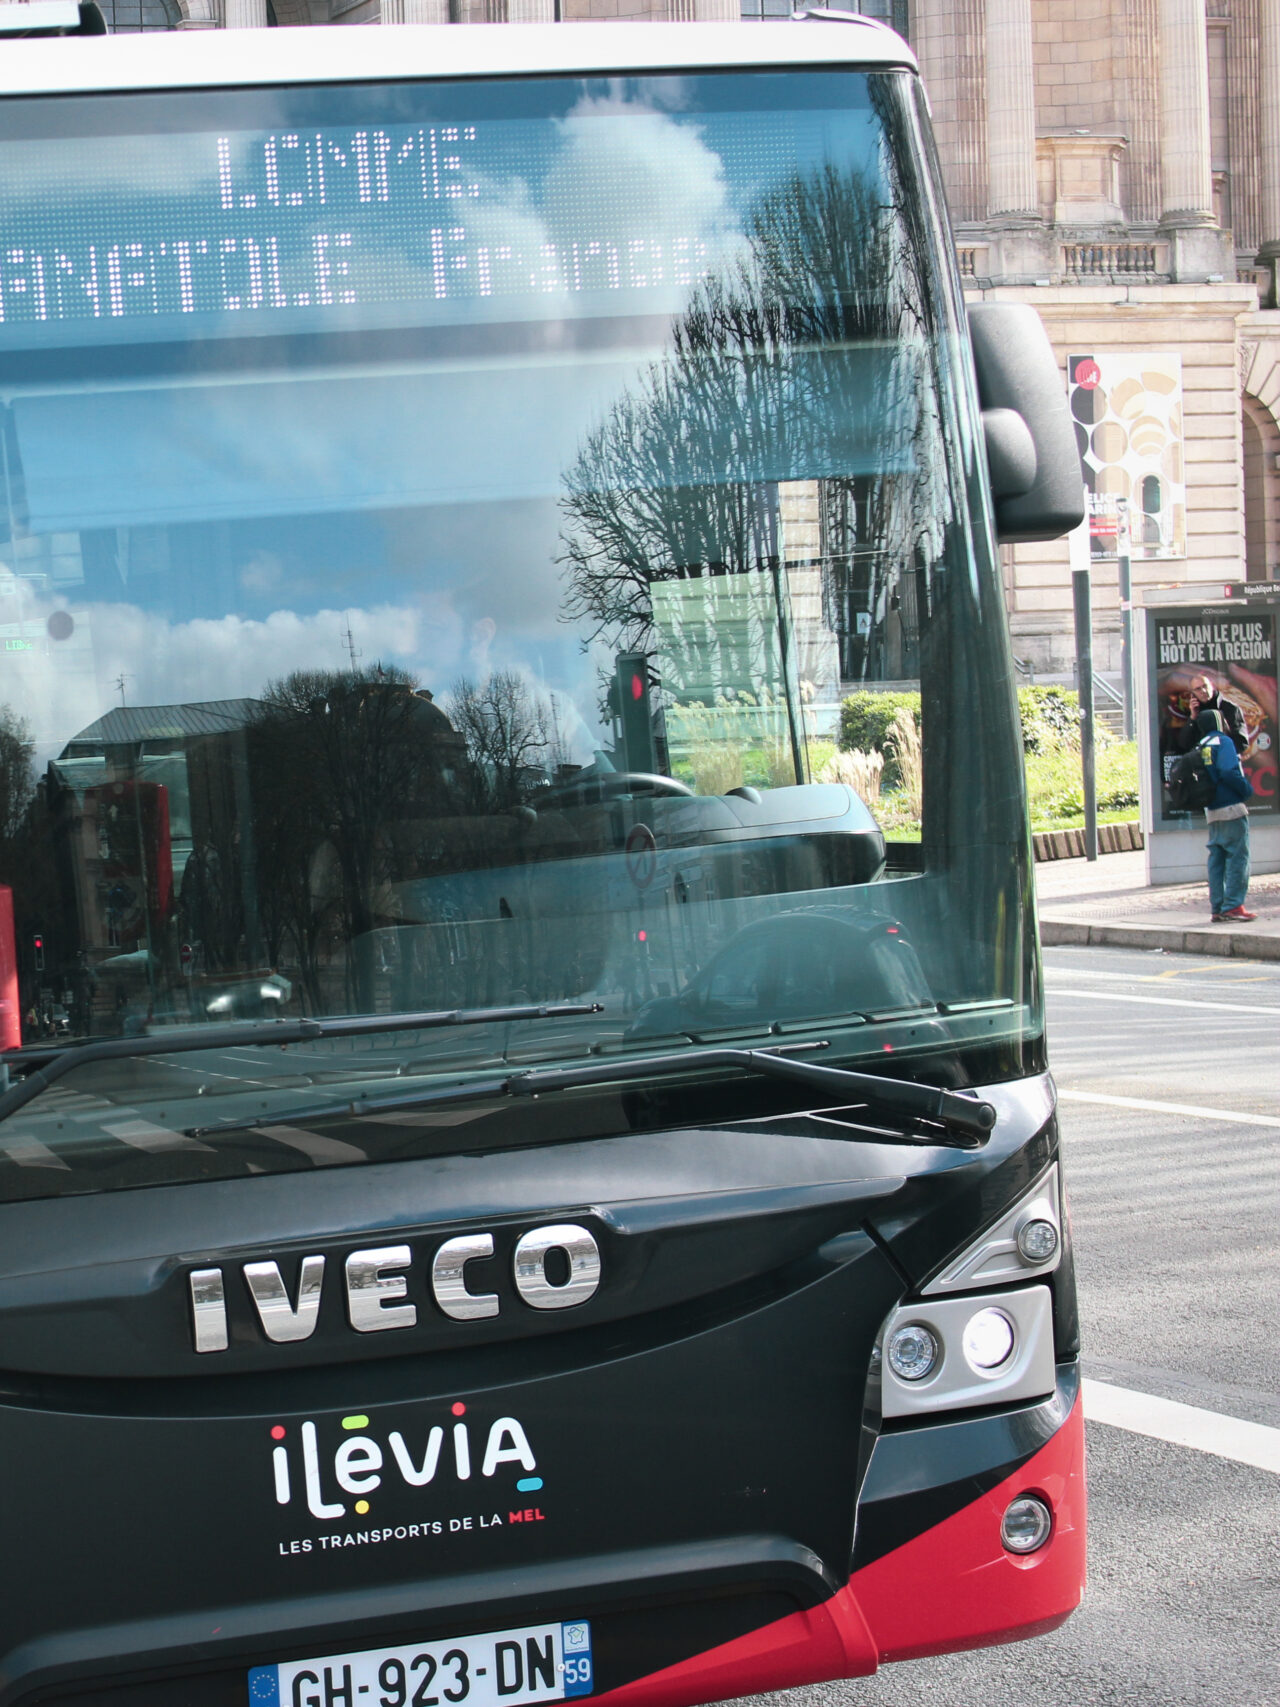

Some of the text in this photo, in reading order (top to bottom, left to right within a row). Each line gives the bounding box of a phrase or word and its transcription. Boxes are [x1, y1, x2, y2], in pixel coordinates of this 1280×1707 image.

[217, 126, 480, 210] LOMME
[1159, 622, 1263, 645] LE NAAN LE PLUS
[1160, 640, 1271, 664] HOT DE TA RÉGION
[189, 1223, 602, 1354] IVECO
[279, 1508, 545, 1555] LES TRANSPORTS DE LA MEL
[291, 1634, 556, 1707] GH-923-DN
[564, 1657, 591, 1684] 59
